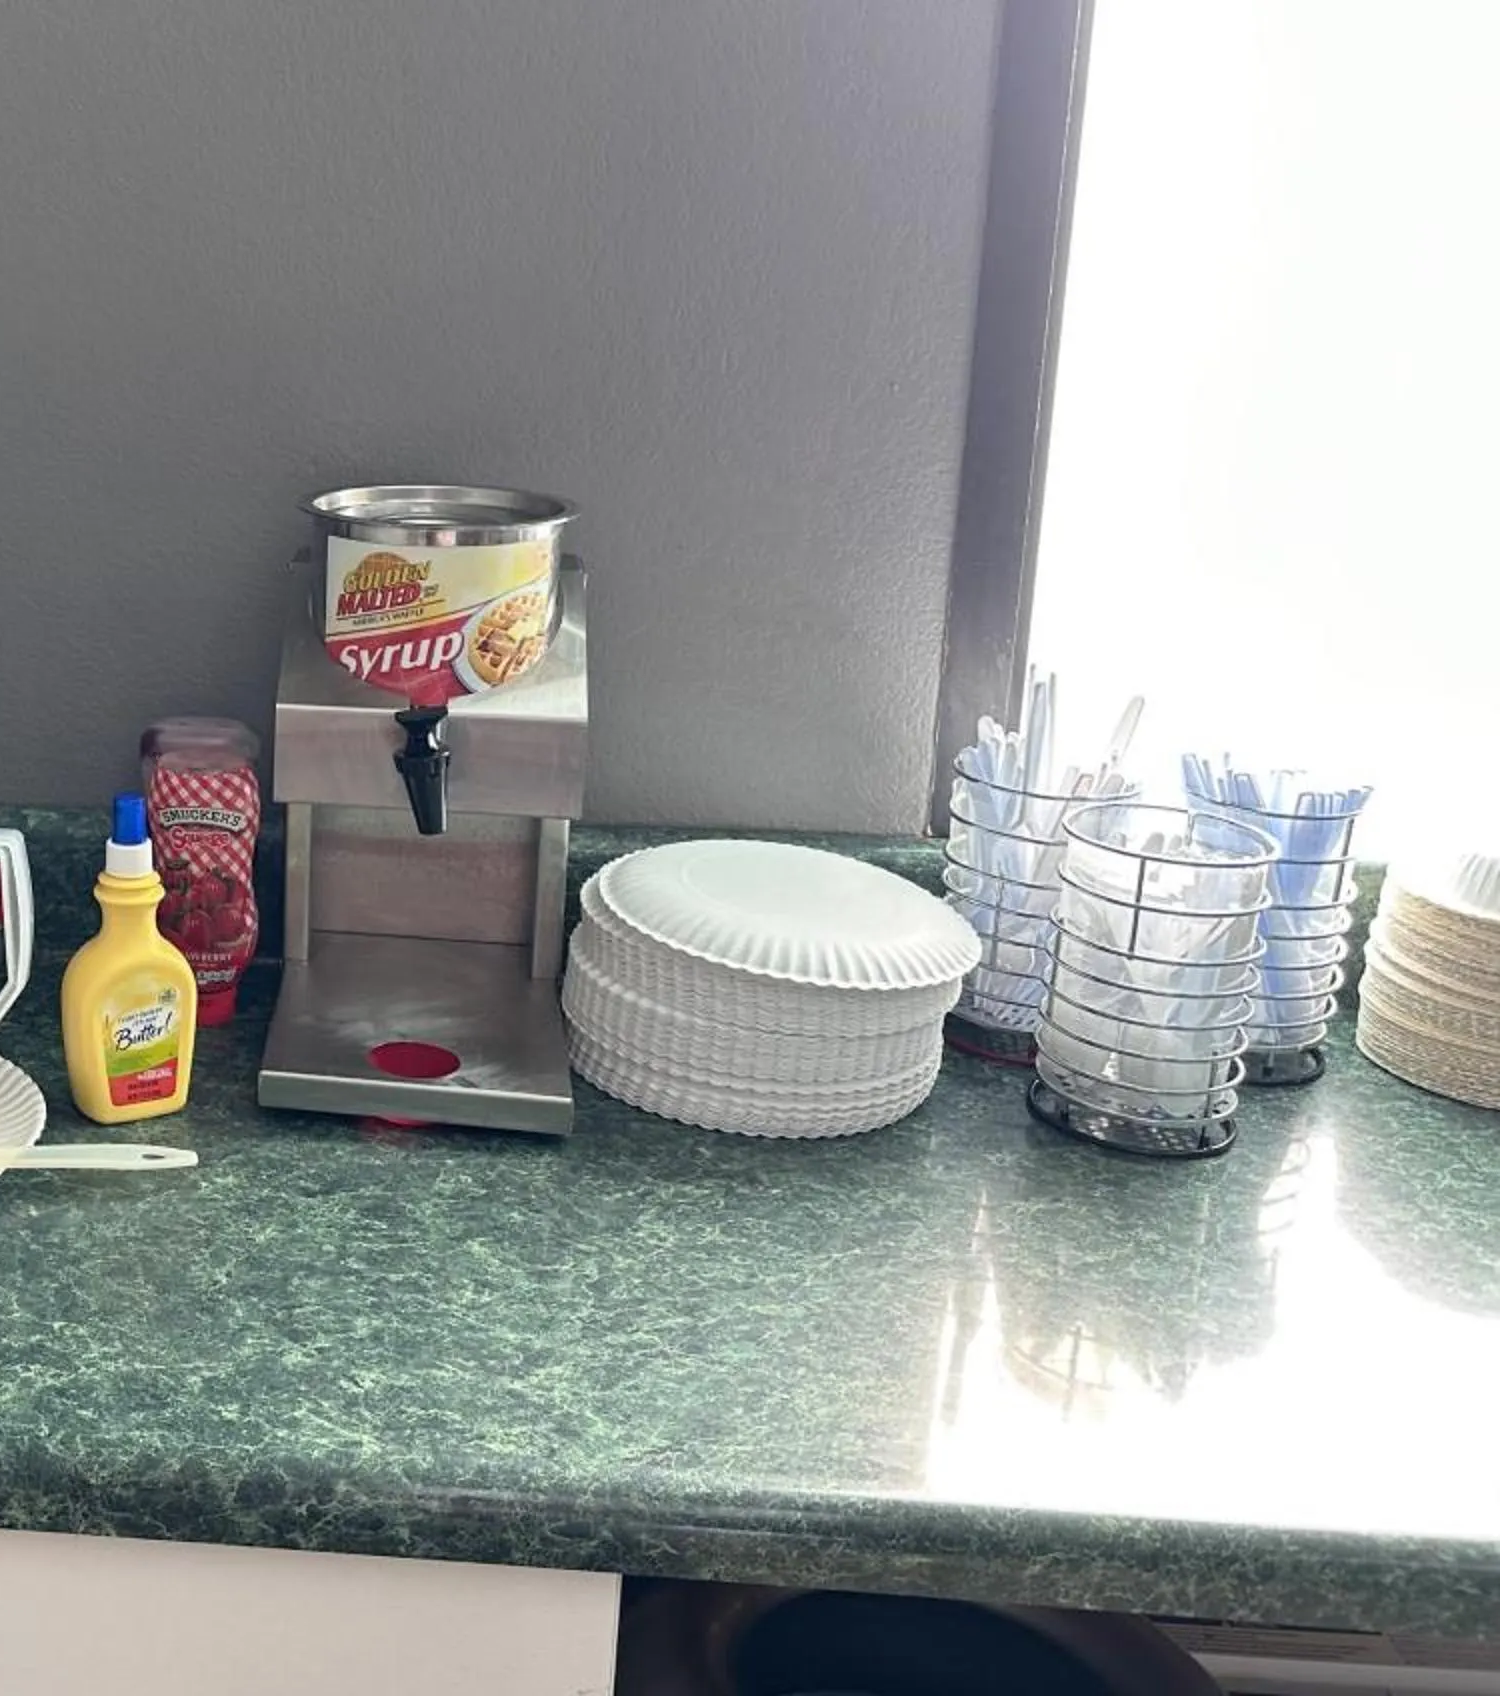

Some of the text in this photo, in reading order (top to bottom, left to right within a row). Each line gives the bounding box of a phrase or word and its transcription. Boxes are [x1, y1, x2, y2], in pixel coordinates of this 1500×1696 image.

[343, 560, 431, 593] GOLDEN
[336, 581, 422, 616] MALTED
[340, 631, 463, 680] Syrup
[161, 808, 242, 828] SMUCKER'S
[171, 826, 232, 850] Squeeze
[114, 1011, 173, 1053] Butter!
